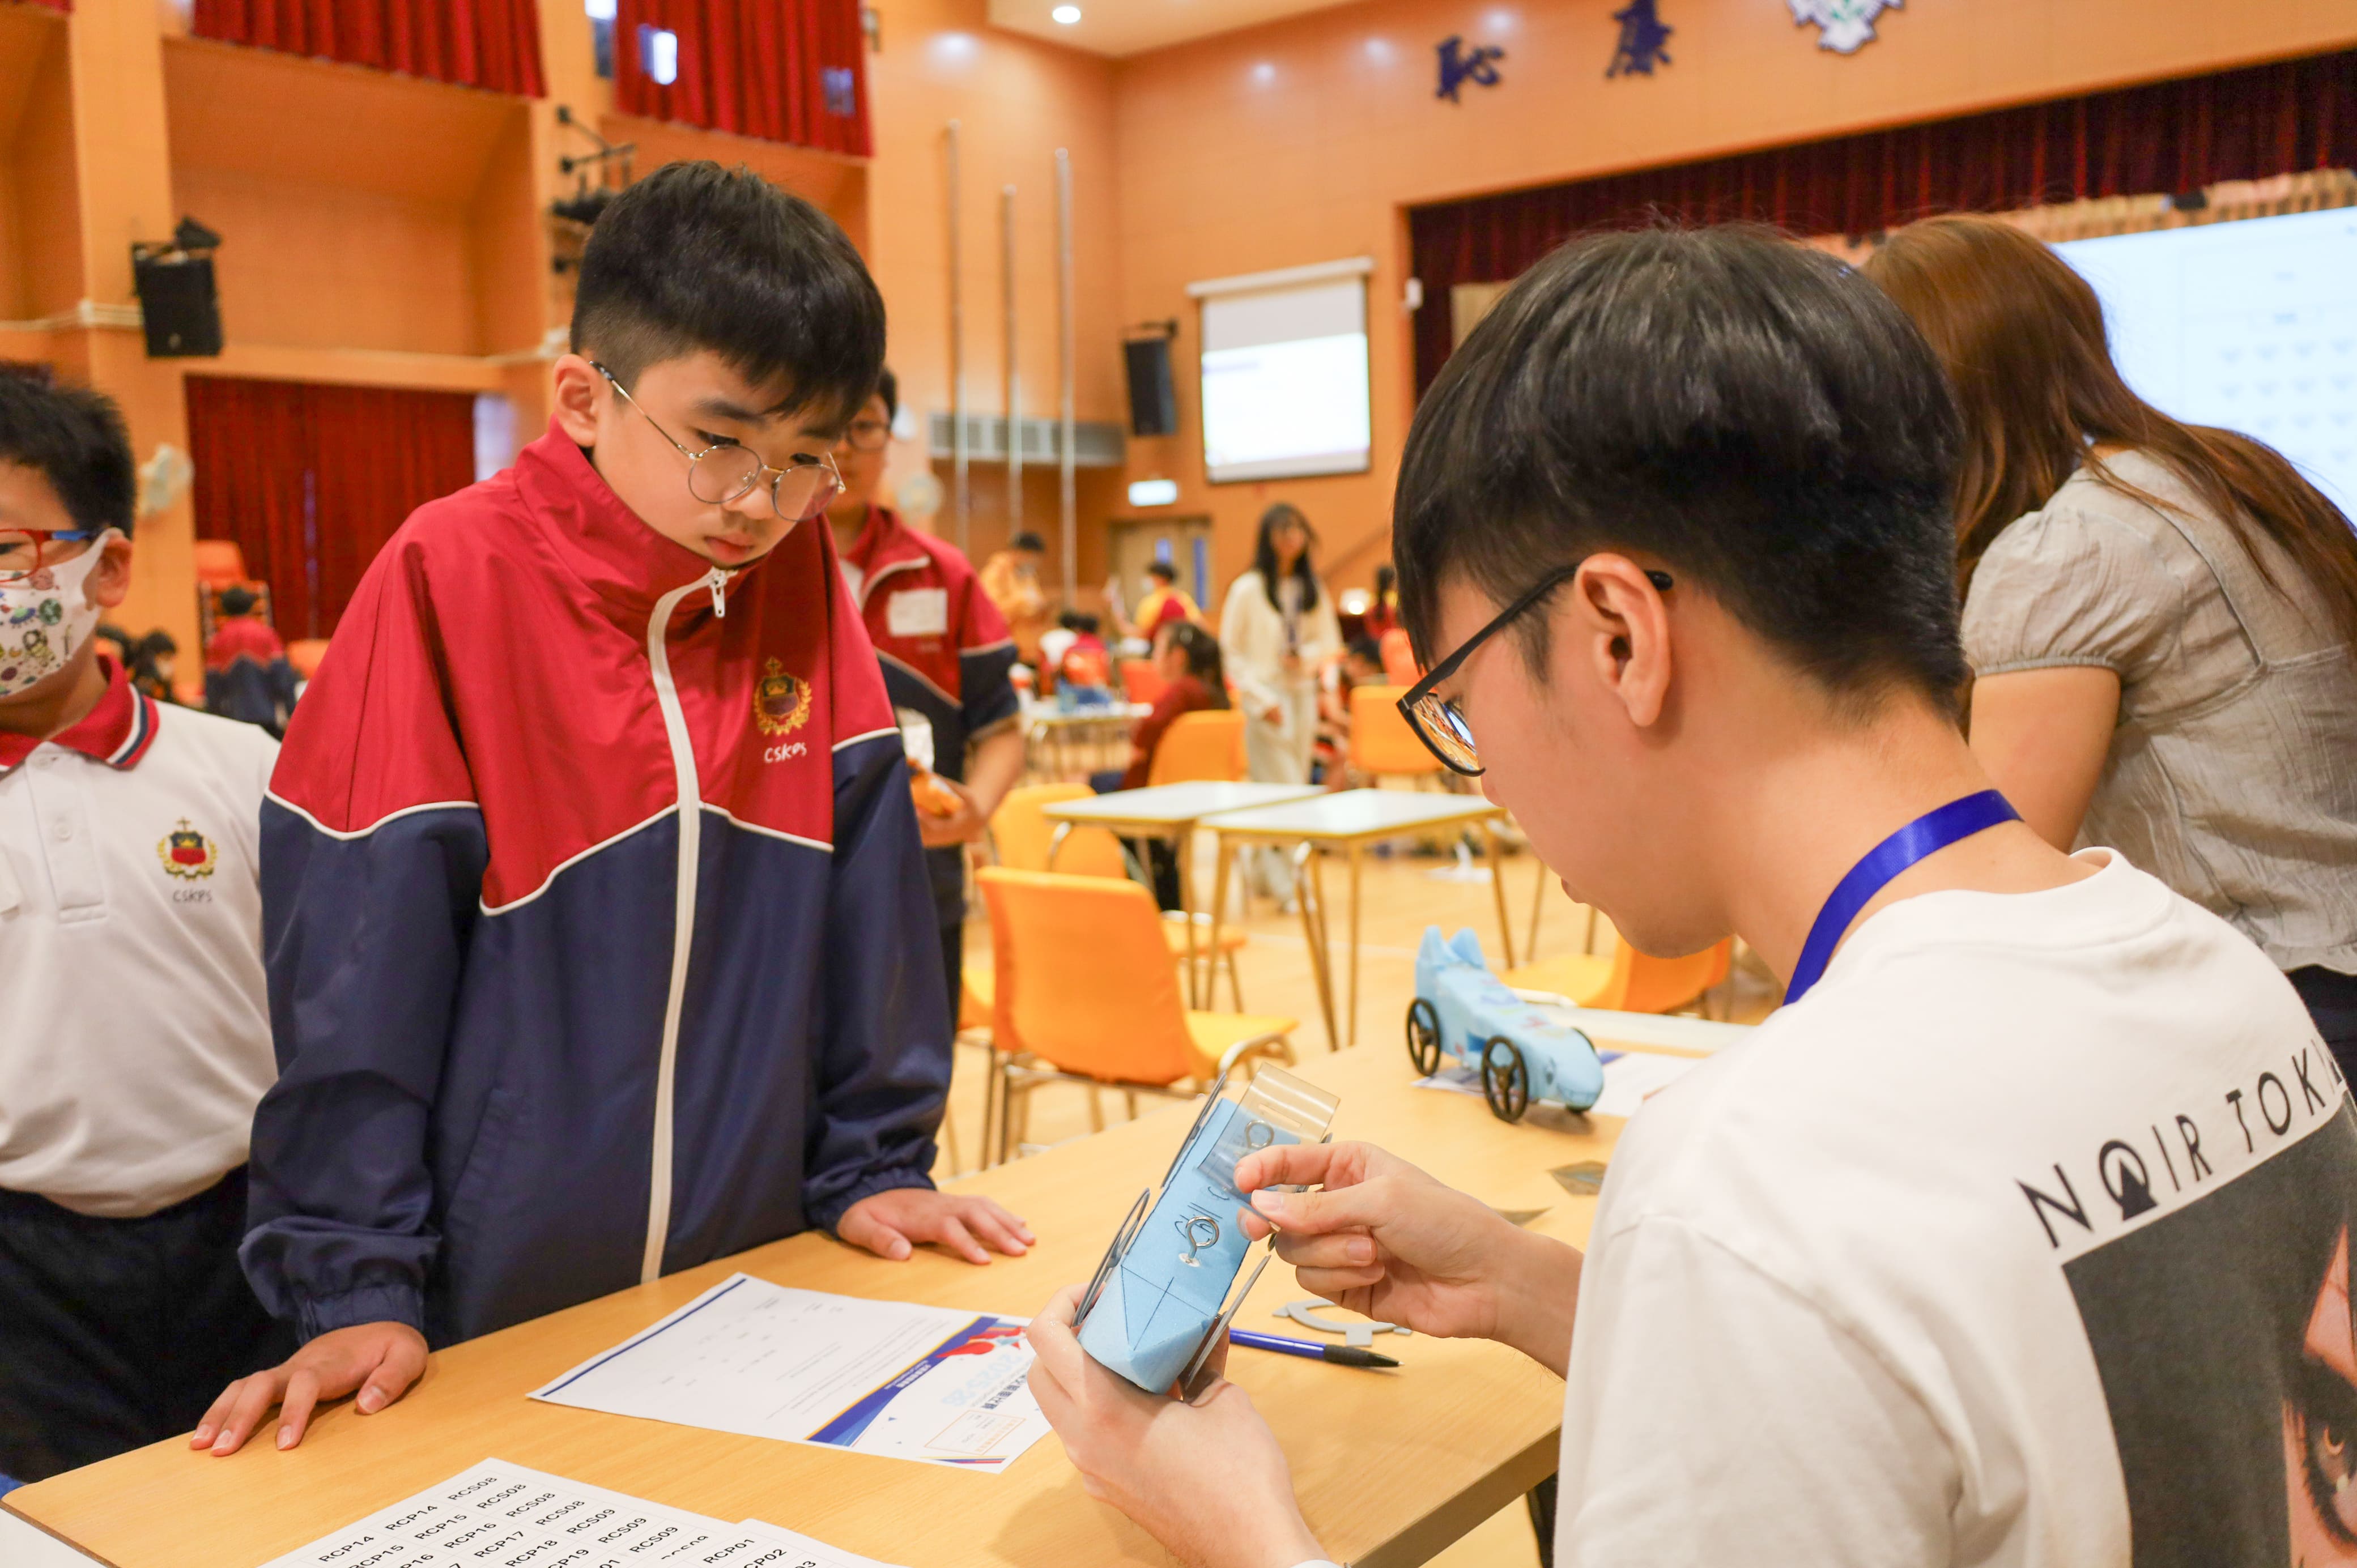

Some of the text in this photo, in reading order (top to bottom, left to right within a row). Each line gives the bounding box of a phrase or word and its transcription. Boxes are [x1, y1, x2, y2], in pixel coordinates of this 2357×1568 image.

[2014, 1114, 2213, 1250] NOIR
[318, 1477, 497, 1562] RCP14 RCP14 RCS08
[414, 1514, 467, 1540] RCP15
[476, 1484, 527, 1509] RCS08
[444, 1523, 497, 1549] RCP16
[506, 1493, 556, 1518] RCS08
[474, 1501, 585, 1558] RCP17 RCS08
[505, 1509, 616, 1567] RCP18 RCS09
[629, 1527, 678, 1553] RCS09
[548, 1549, 589, 1568] CP19
[598, 1518, 647, 1544] RCS09
[703, 1539, 755, 1563] RCP01
